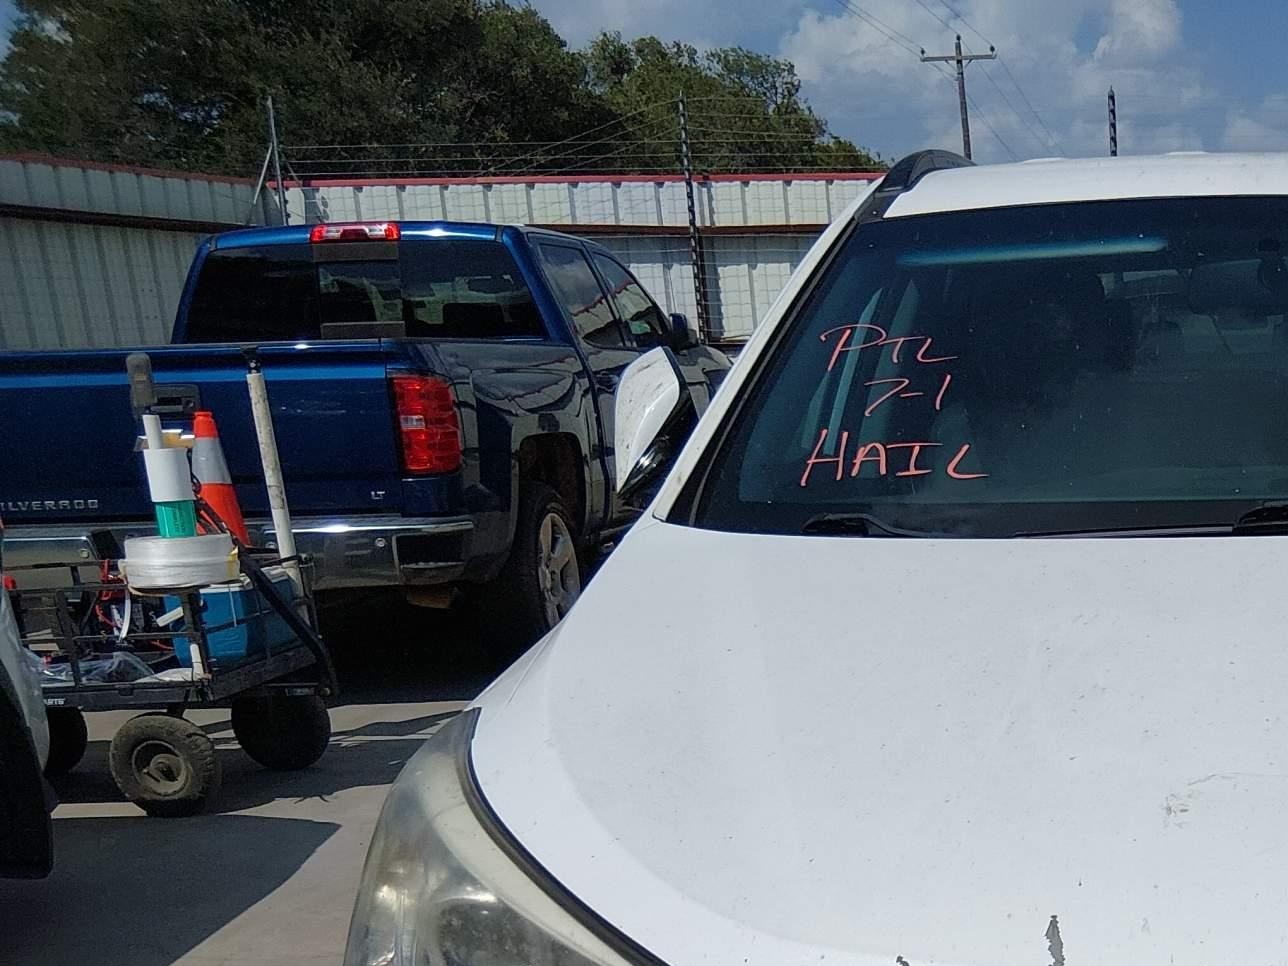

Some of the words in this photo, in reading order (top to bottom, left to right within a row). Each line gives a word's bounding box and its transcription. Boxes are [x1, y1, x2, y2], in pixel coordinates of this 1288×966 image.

[863, 373, 952, 418] 7-1
[800, 428, 990, 487] HAIL
[370, 490, 386, 500] LT
